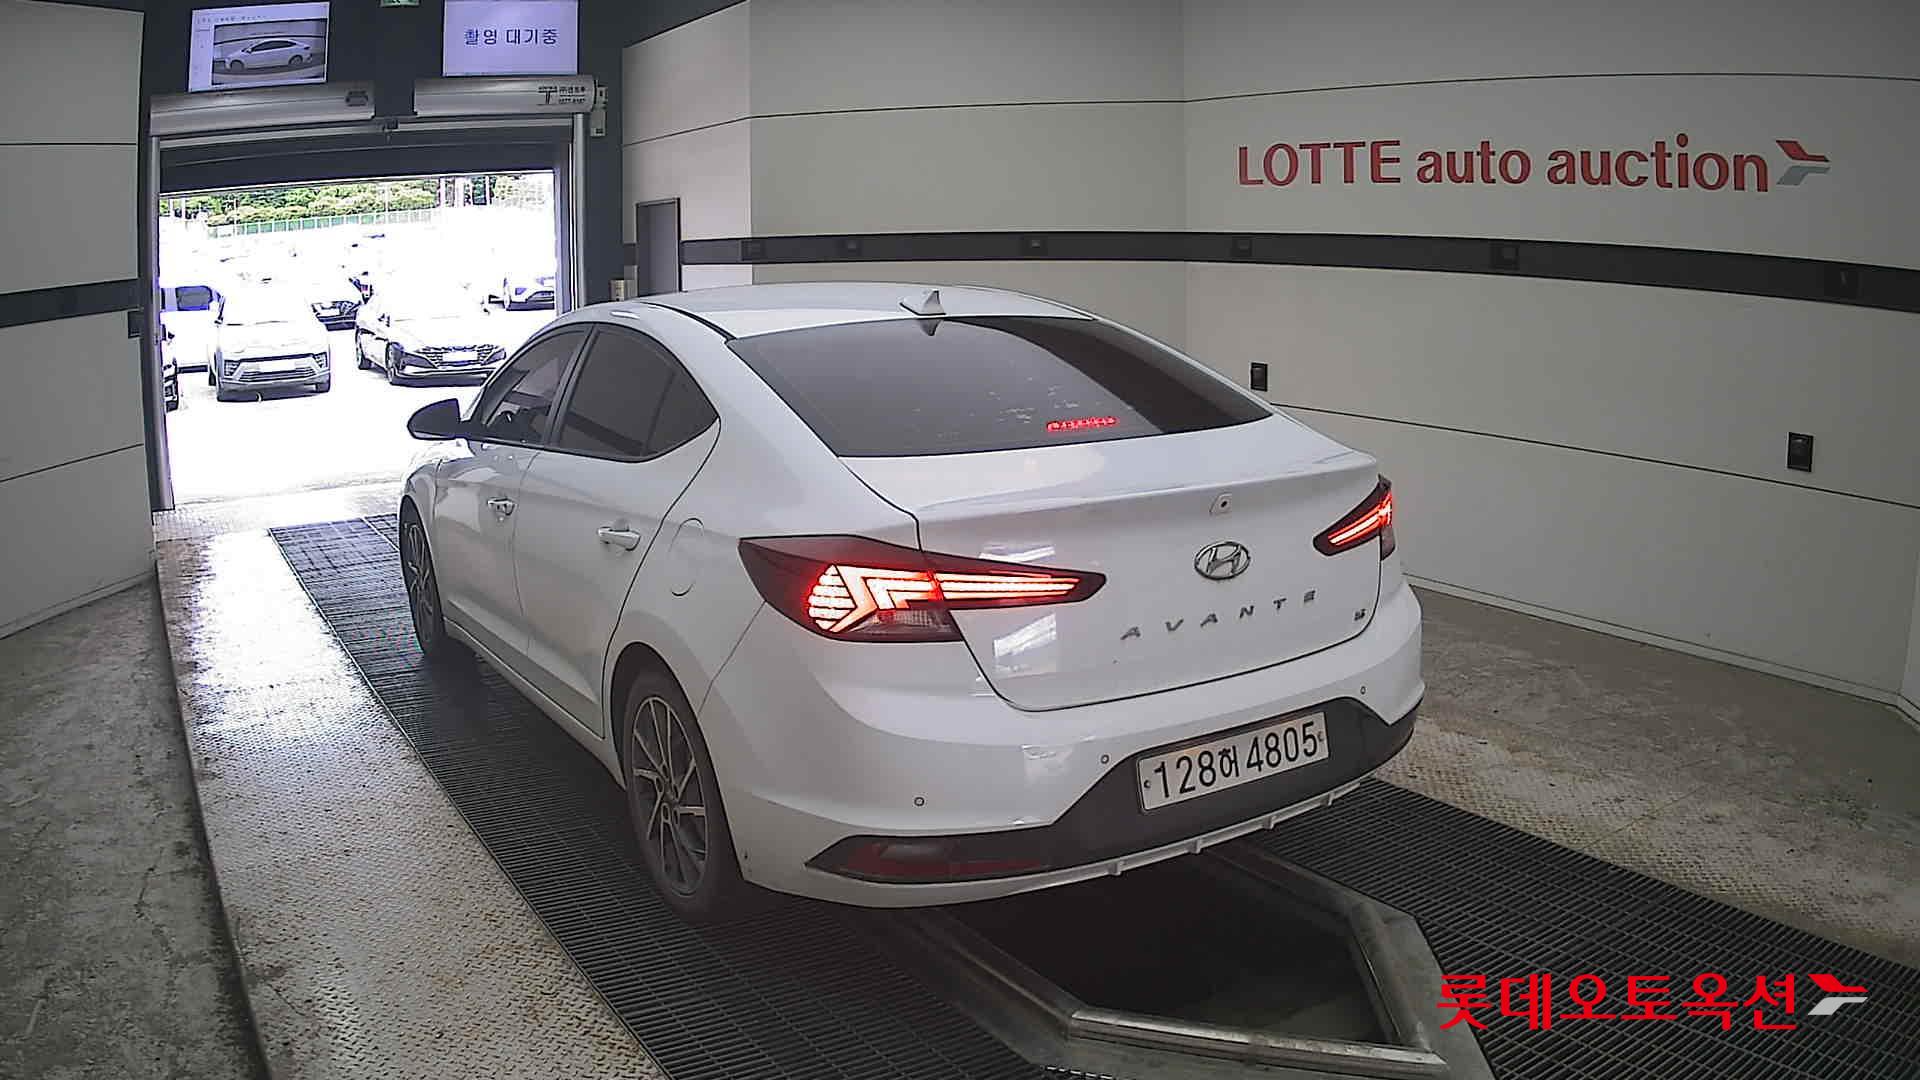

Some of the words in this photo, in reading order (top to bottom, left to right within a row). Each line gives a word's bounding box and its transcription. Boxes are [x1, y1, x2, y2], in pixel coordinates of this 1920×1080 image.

[465, 28, 498, 46] 촬영
[506, 28, 558, 46] 대기중
[1239, 139, 1401, 187] LOTTE
[1416, 140, 1532, 184] auto
[1547, 133, 1769, 192] auction
[1121, 590, 1317, 640] AVANTE
